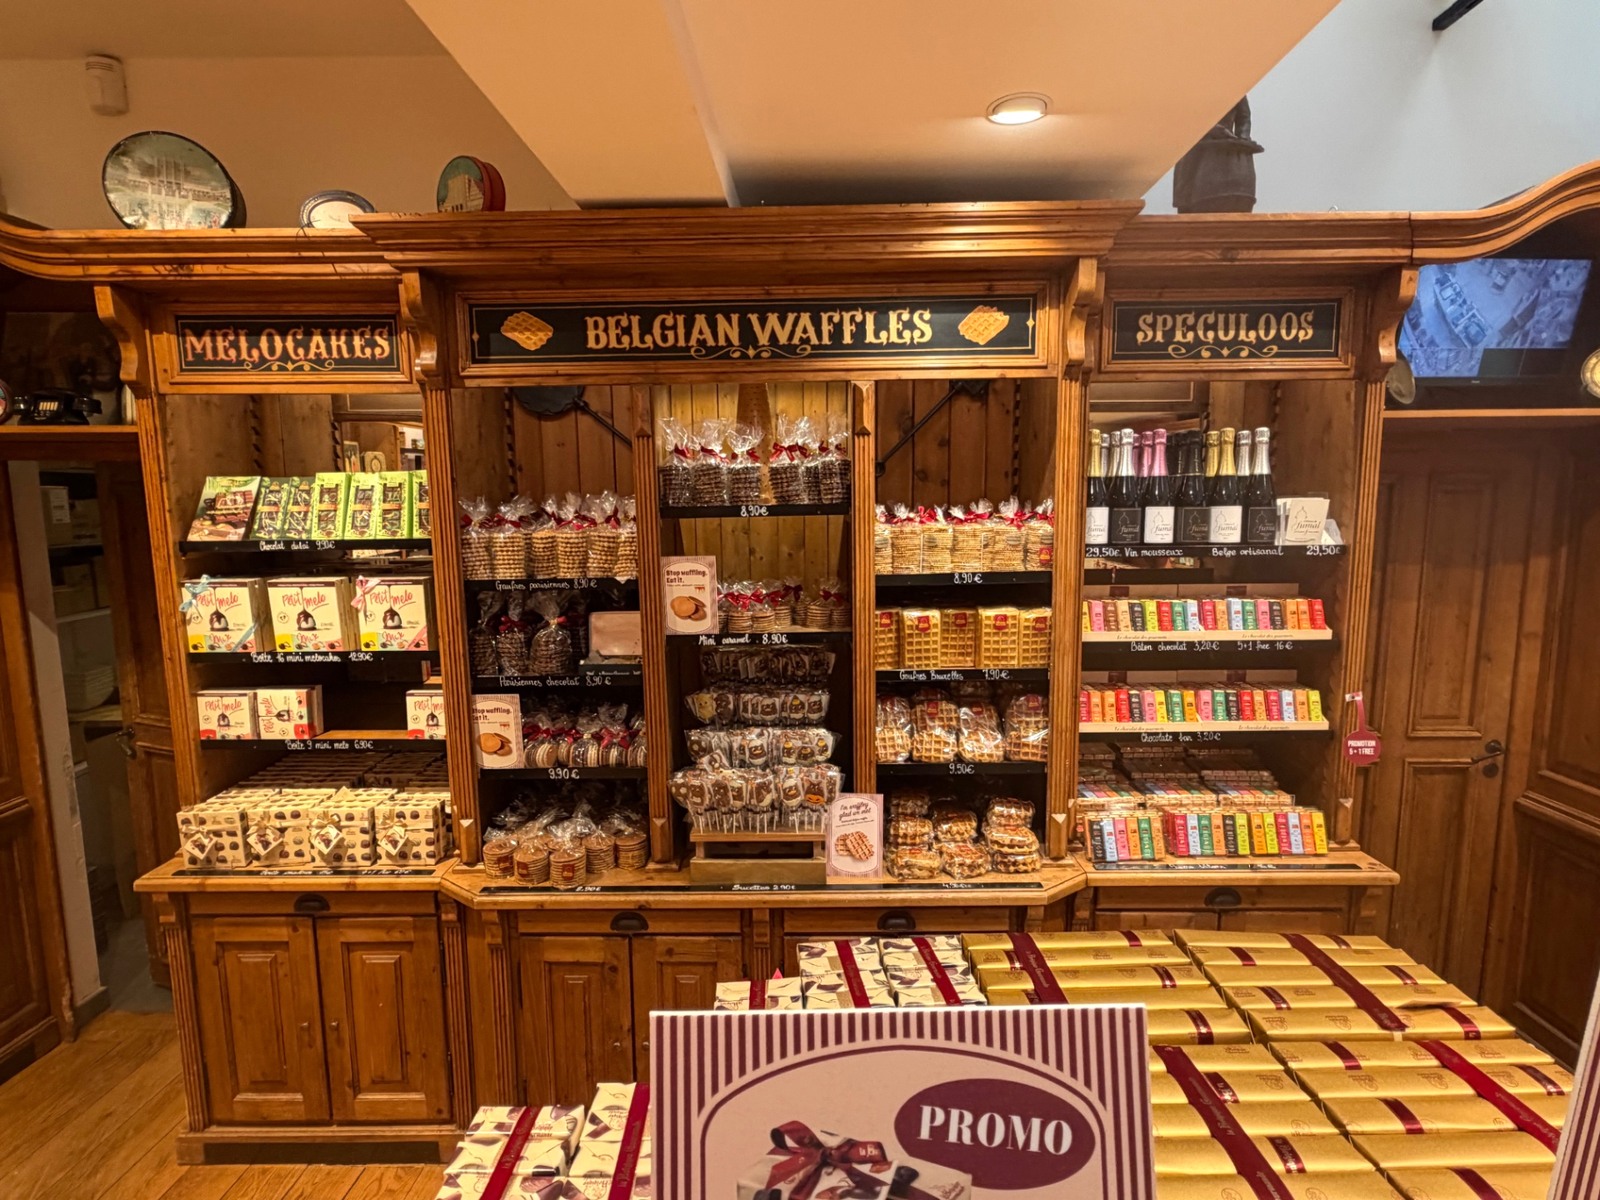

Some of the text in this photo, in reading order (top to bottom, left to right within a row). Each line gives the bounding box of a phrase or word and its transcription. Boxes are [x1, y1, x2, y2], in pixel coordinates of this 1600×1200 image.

[584, 306, 932, 350] BELGIAN WAFFLES
[1136, 310, 1314, 346] SPECULOOS
[183, 325, 391, 363] MELOCAKES
[259, 541, 285, 552] Chocolat
[1124, 547, 1139, 558] Vin
[1141, 549, 1183, 557] mousseux
[1240, 545, 1284, 556] artisanal
[681, 569, 708, 577] waffling.
[196, 591, 239, 608] Petit melo
[282, 591, 326, 608] Petit melo
[370, 589, 413, 607] Petit melo
[698, 635, 716, 646] Mini
[722, 635, 751, 645] caramel
[1158, 641, 1187, 651] chocolat
[1256, 641, 1270, 651] free
[276, 653, 285, 663] 16
[286, 652, 303, 662] mini
[500, 676, 542, 687] Parisiennes
[546, 676, 580, 686] chocolat
[205, 699, 241, 712] Petit melo
[1141, 732, 1173, 742] Chocolate
[306, 740, 312, 749] 9
[315, 741, 332, 749] mini
[334, 741, 349, 749] melo
[1362, 747, 1375, 755] FREE
[917, 1104, 1073, 1156] PROMO
